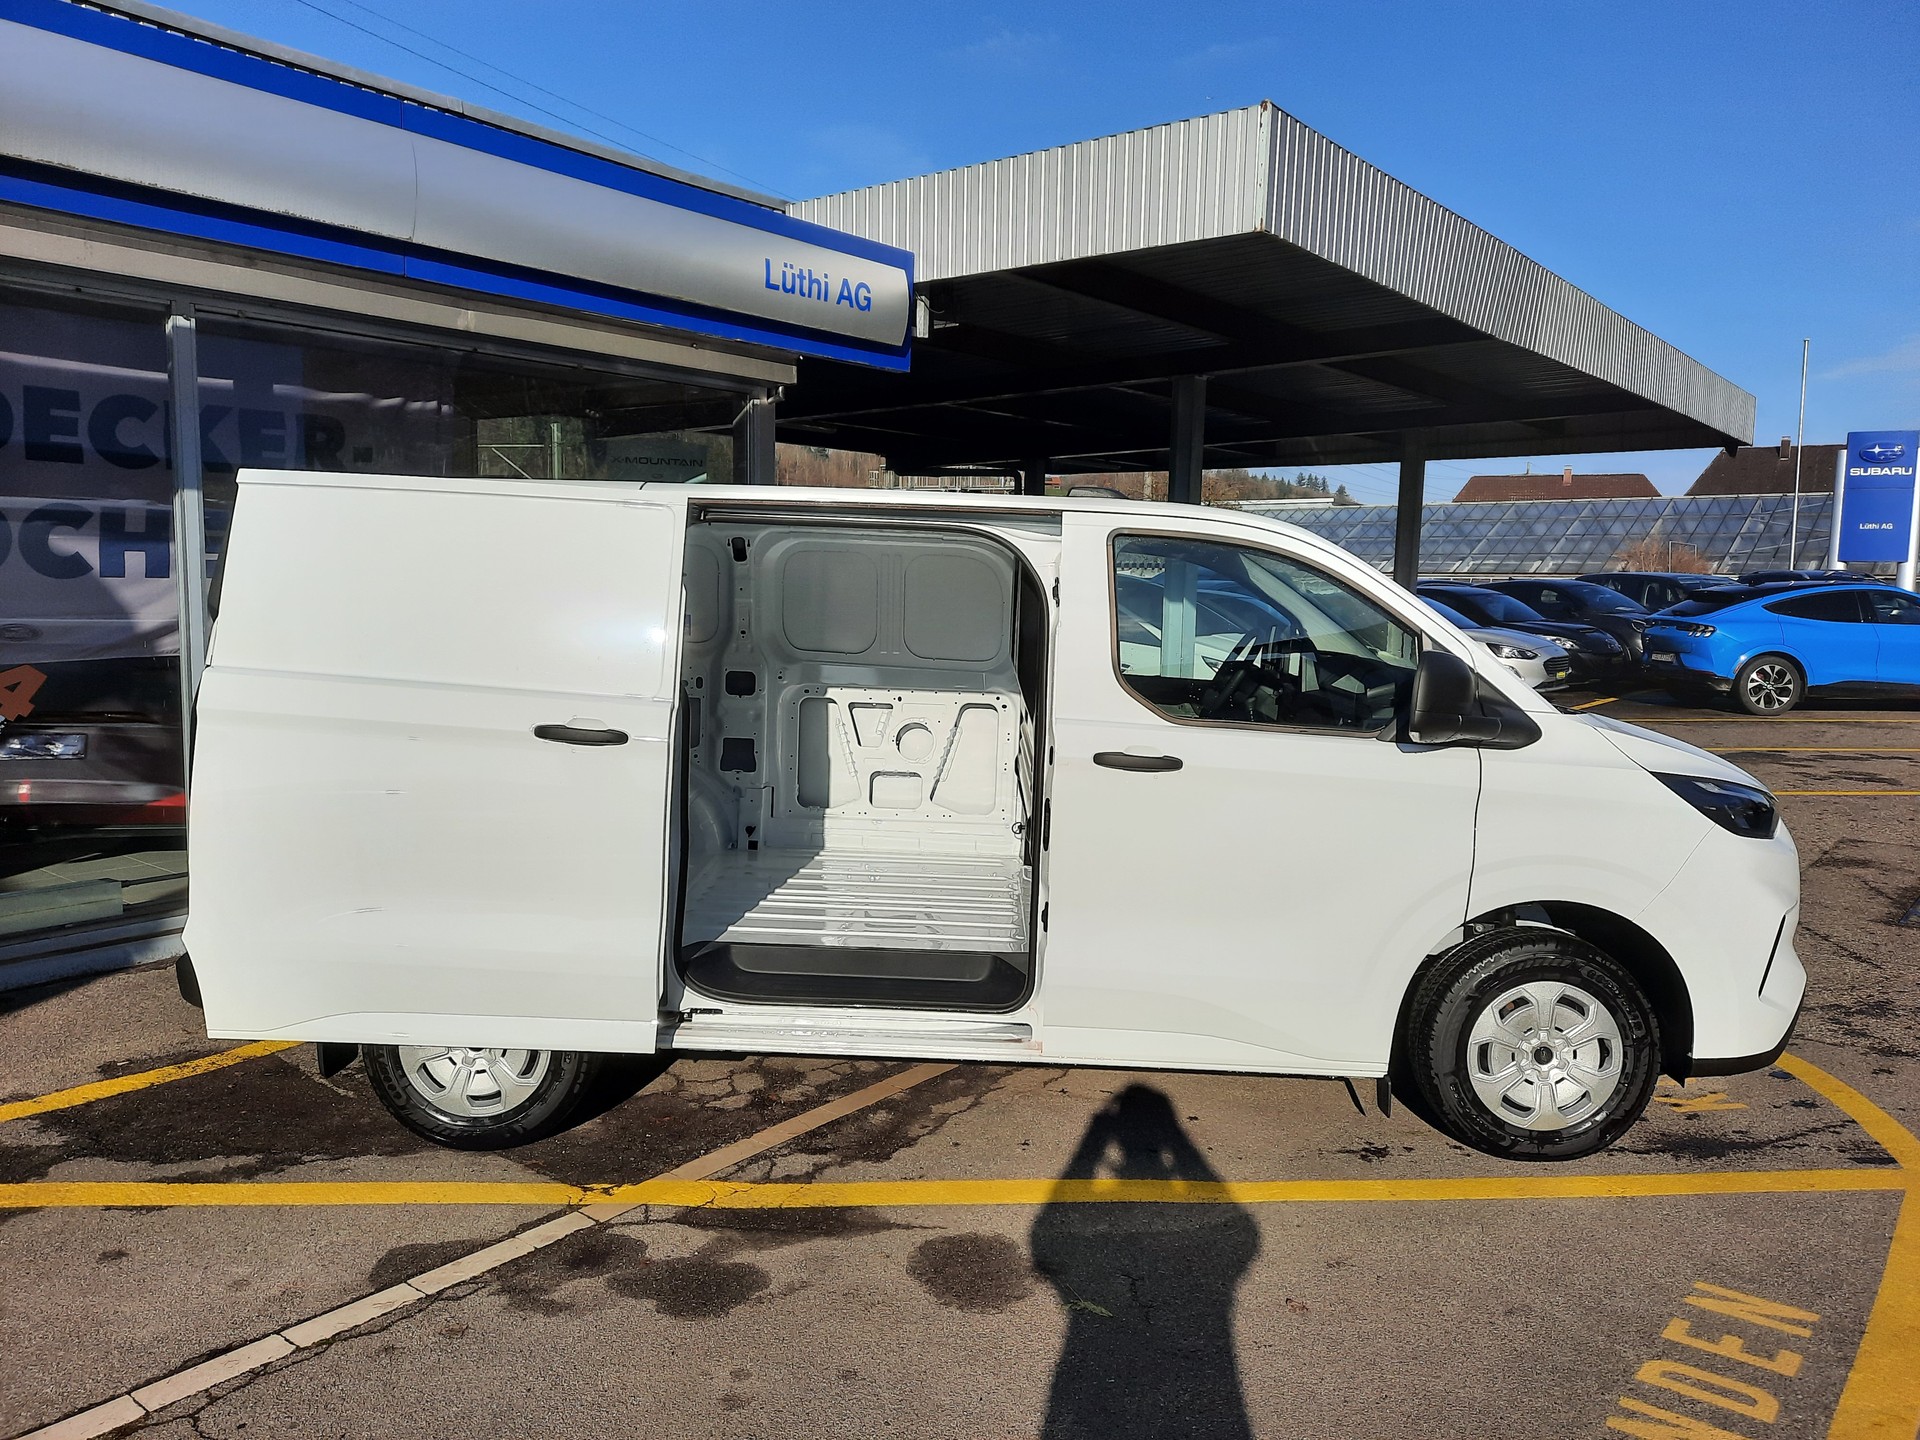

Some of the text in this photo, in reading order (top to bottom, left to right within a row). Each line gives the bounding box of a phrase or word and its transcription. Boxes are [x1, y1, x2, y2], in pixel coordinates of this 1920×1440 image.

[764, 257, 872, 312] Lüthi AG
[1849, 467, 1913, 476] SUBARU
